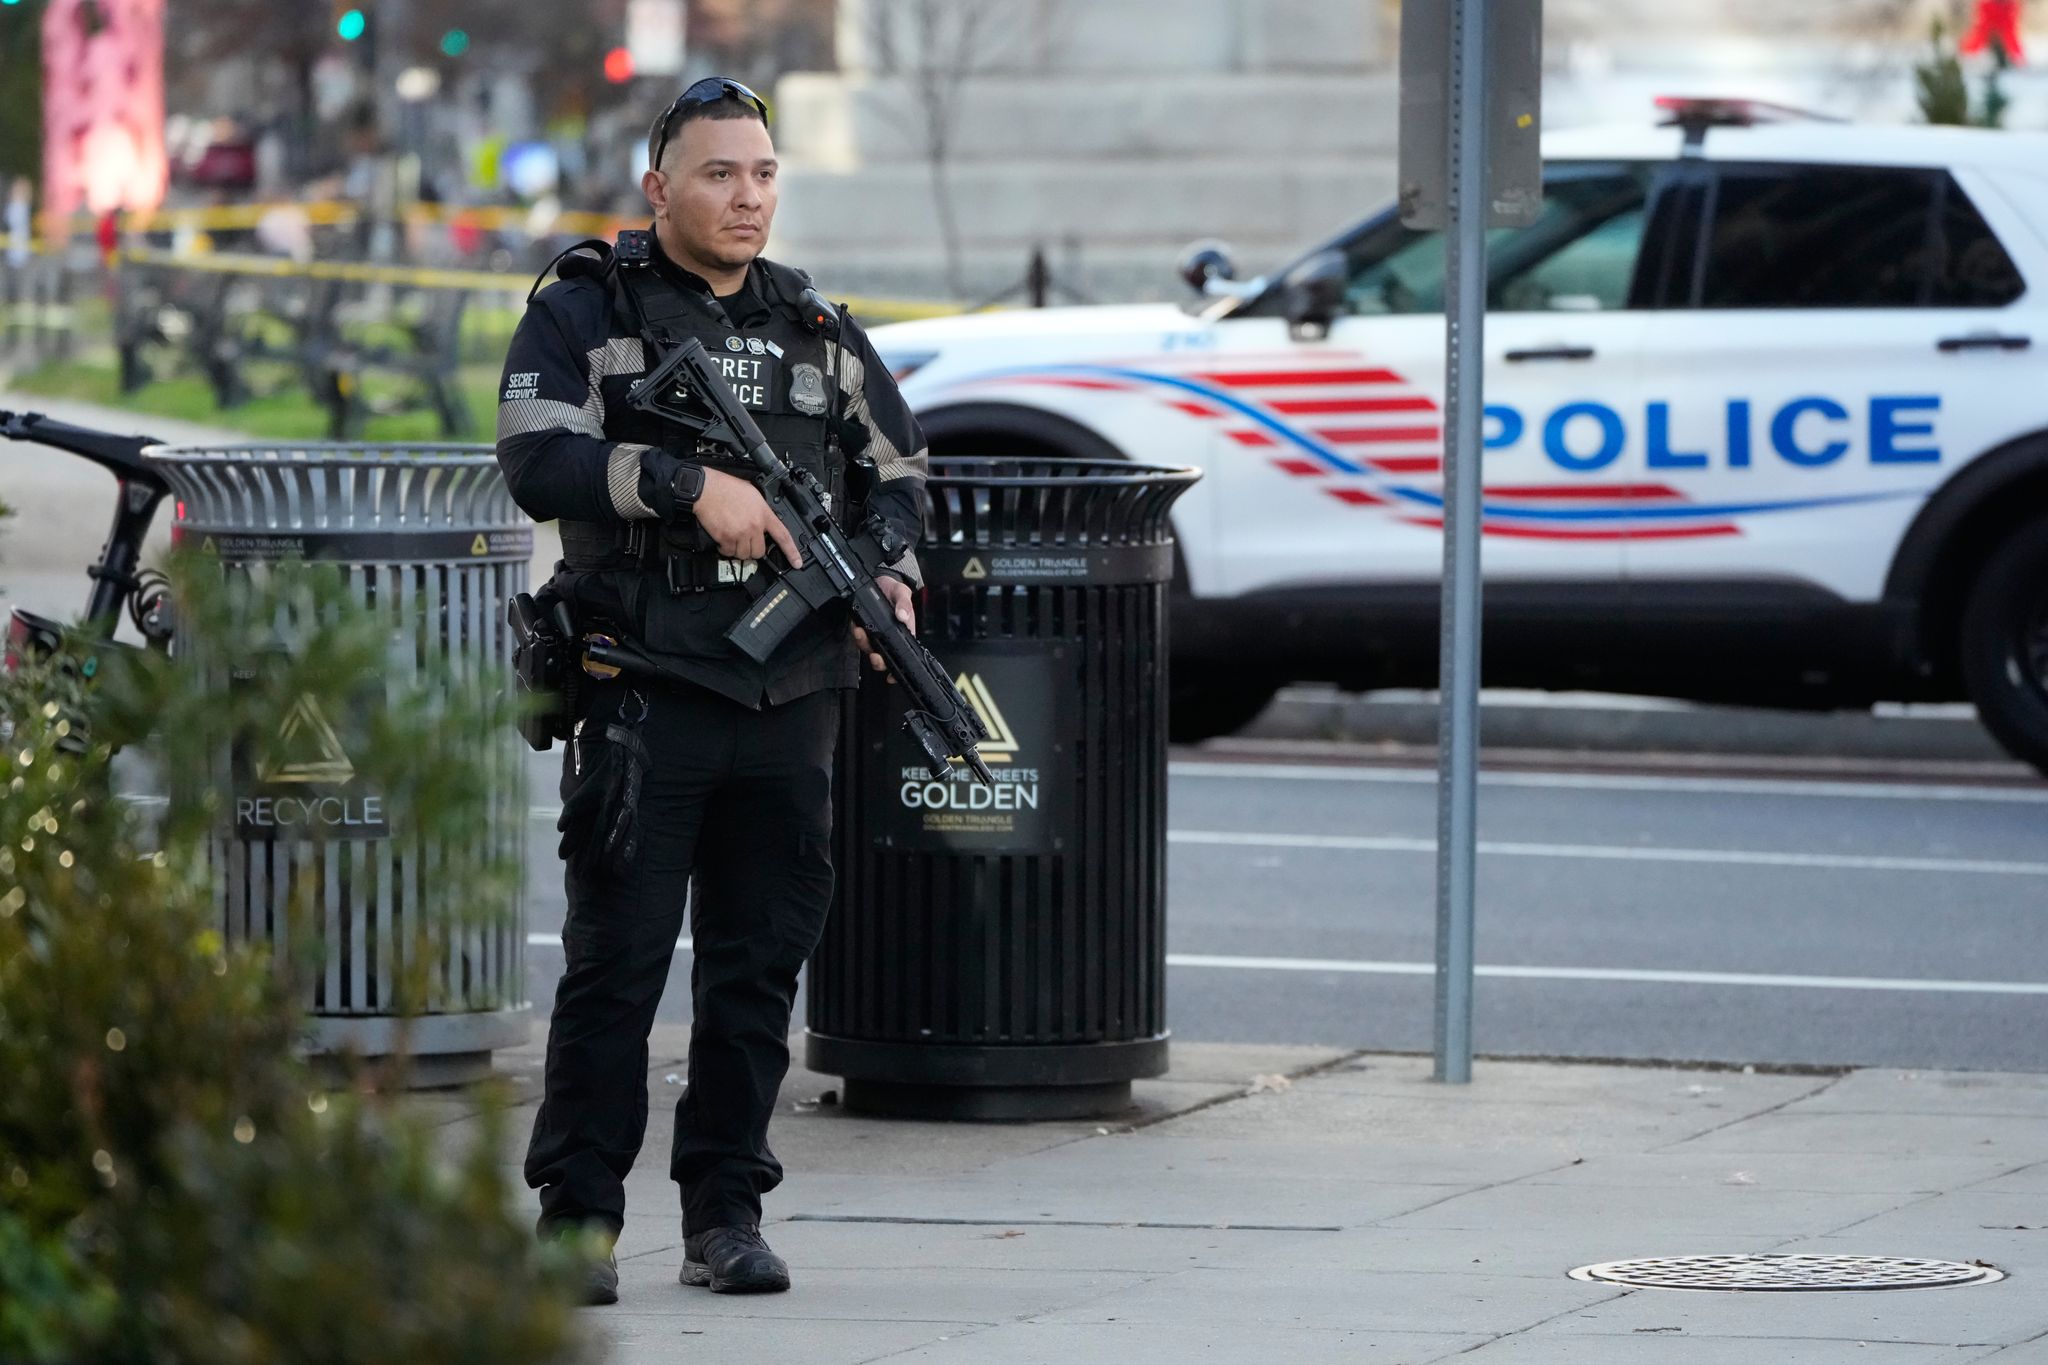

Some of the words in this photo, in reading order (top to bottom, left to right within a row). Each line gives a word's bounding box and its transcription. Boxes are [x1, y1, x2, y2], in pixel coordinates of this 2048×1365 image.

[508, 372, 540, 388] SECRET
[504, 388, 539, 399] SERVICE
[1482, 396, 1941, 472] POLICE
[991, 558, 1036, 568] GOLDEN
[1039, 558, 1087, 568] TRIANGLE
[901, 766, 932, 781] KEE
[945, 768, 971, 782] HE
[974, 768, 1039, 782] REETS
[900, 781, 1039, 810] GOLDEN
[237, 796, 383, 826] RECYCLE
[923, 814, 962, 824] GOLDEN
[965, 814, 1013, 825] TRIANGLE
